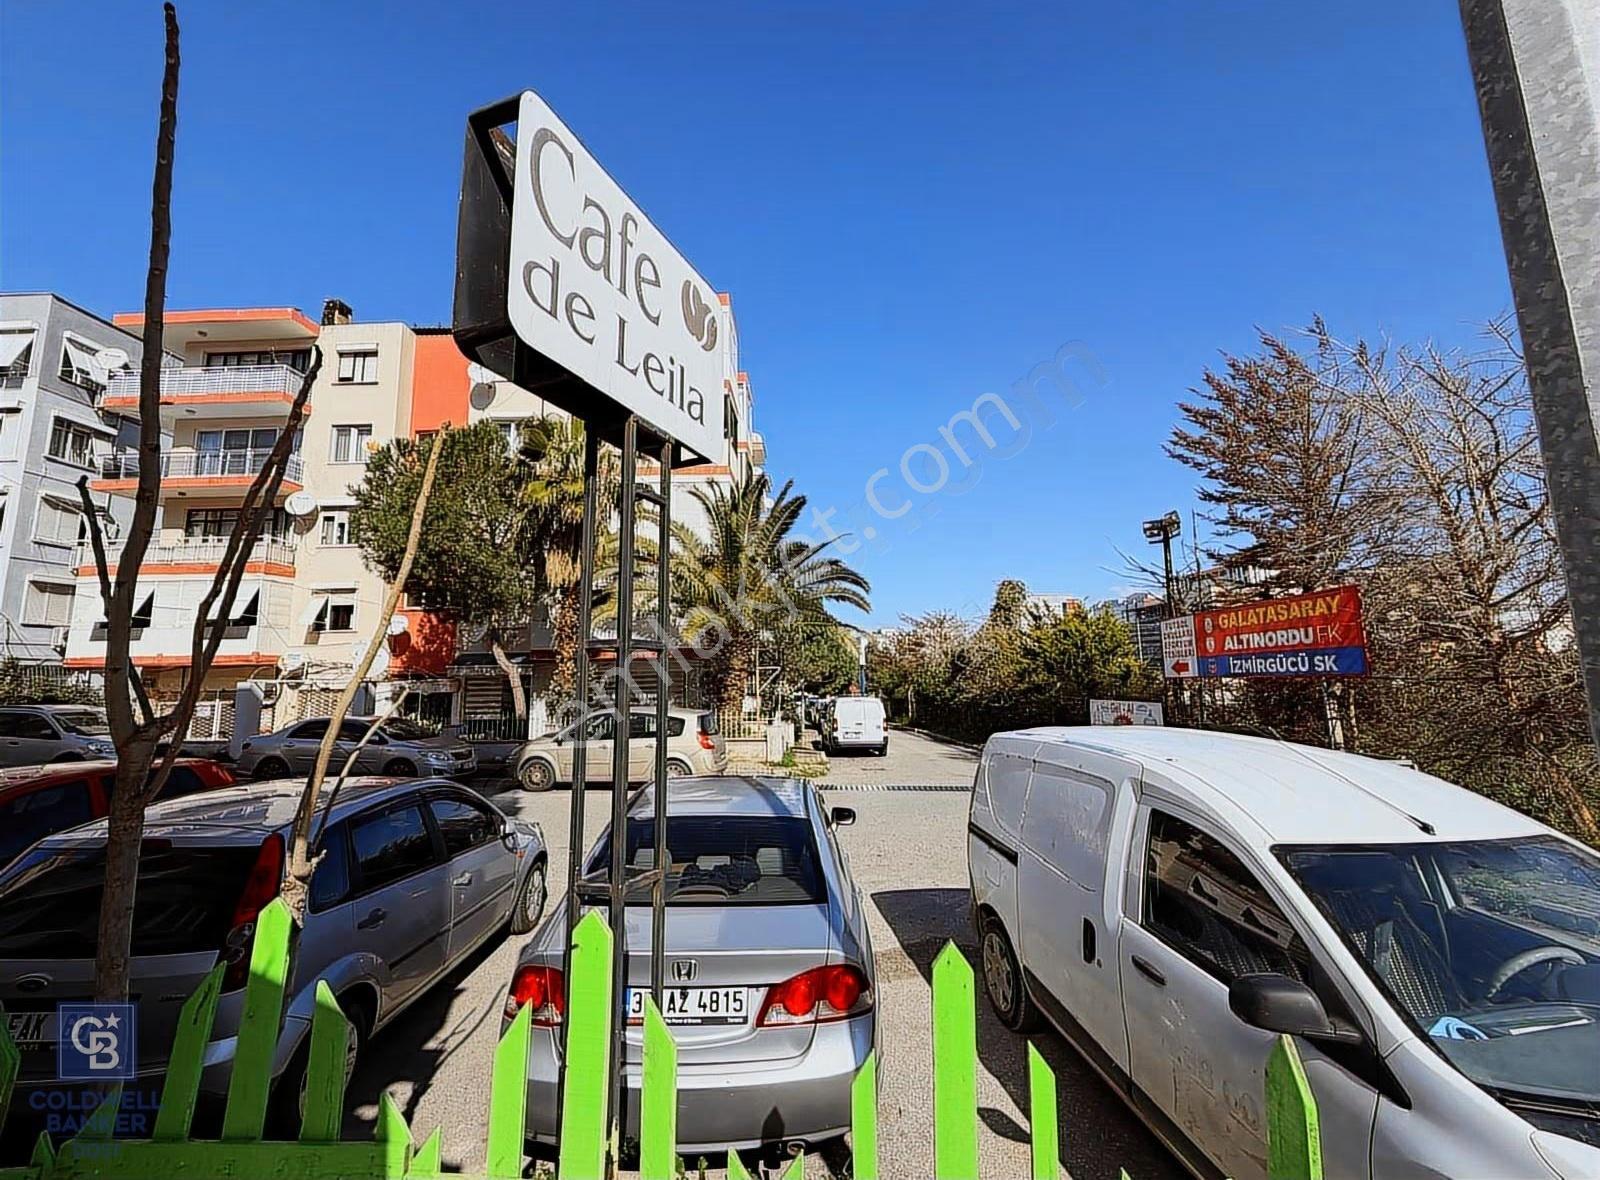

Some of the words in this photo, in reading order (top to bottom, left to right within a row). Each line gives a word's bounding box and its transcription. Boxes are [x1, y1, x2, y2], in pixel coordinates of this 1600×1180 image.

[529, 127, 661, 326] Cafe
[522, 256, 595, 345] de
[615, 313, 705, 427] Leila
[1218, 594, 1340, 629] GALATASARAY
[1224, 626, 1313, 651] ALTINORDU
[1229, 652, 1309, 674] İZMİRGÜCÜ
[1314, 654, 1338, 672] SK
[667, 990, 689, 1014] AZ
[697, 990, 744, 1014] 4815
